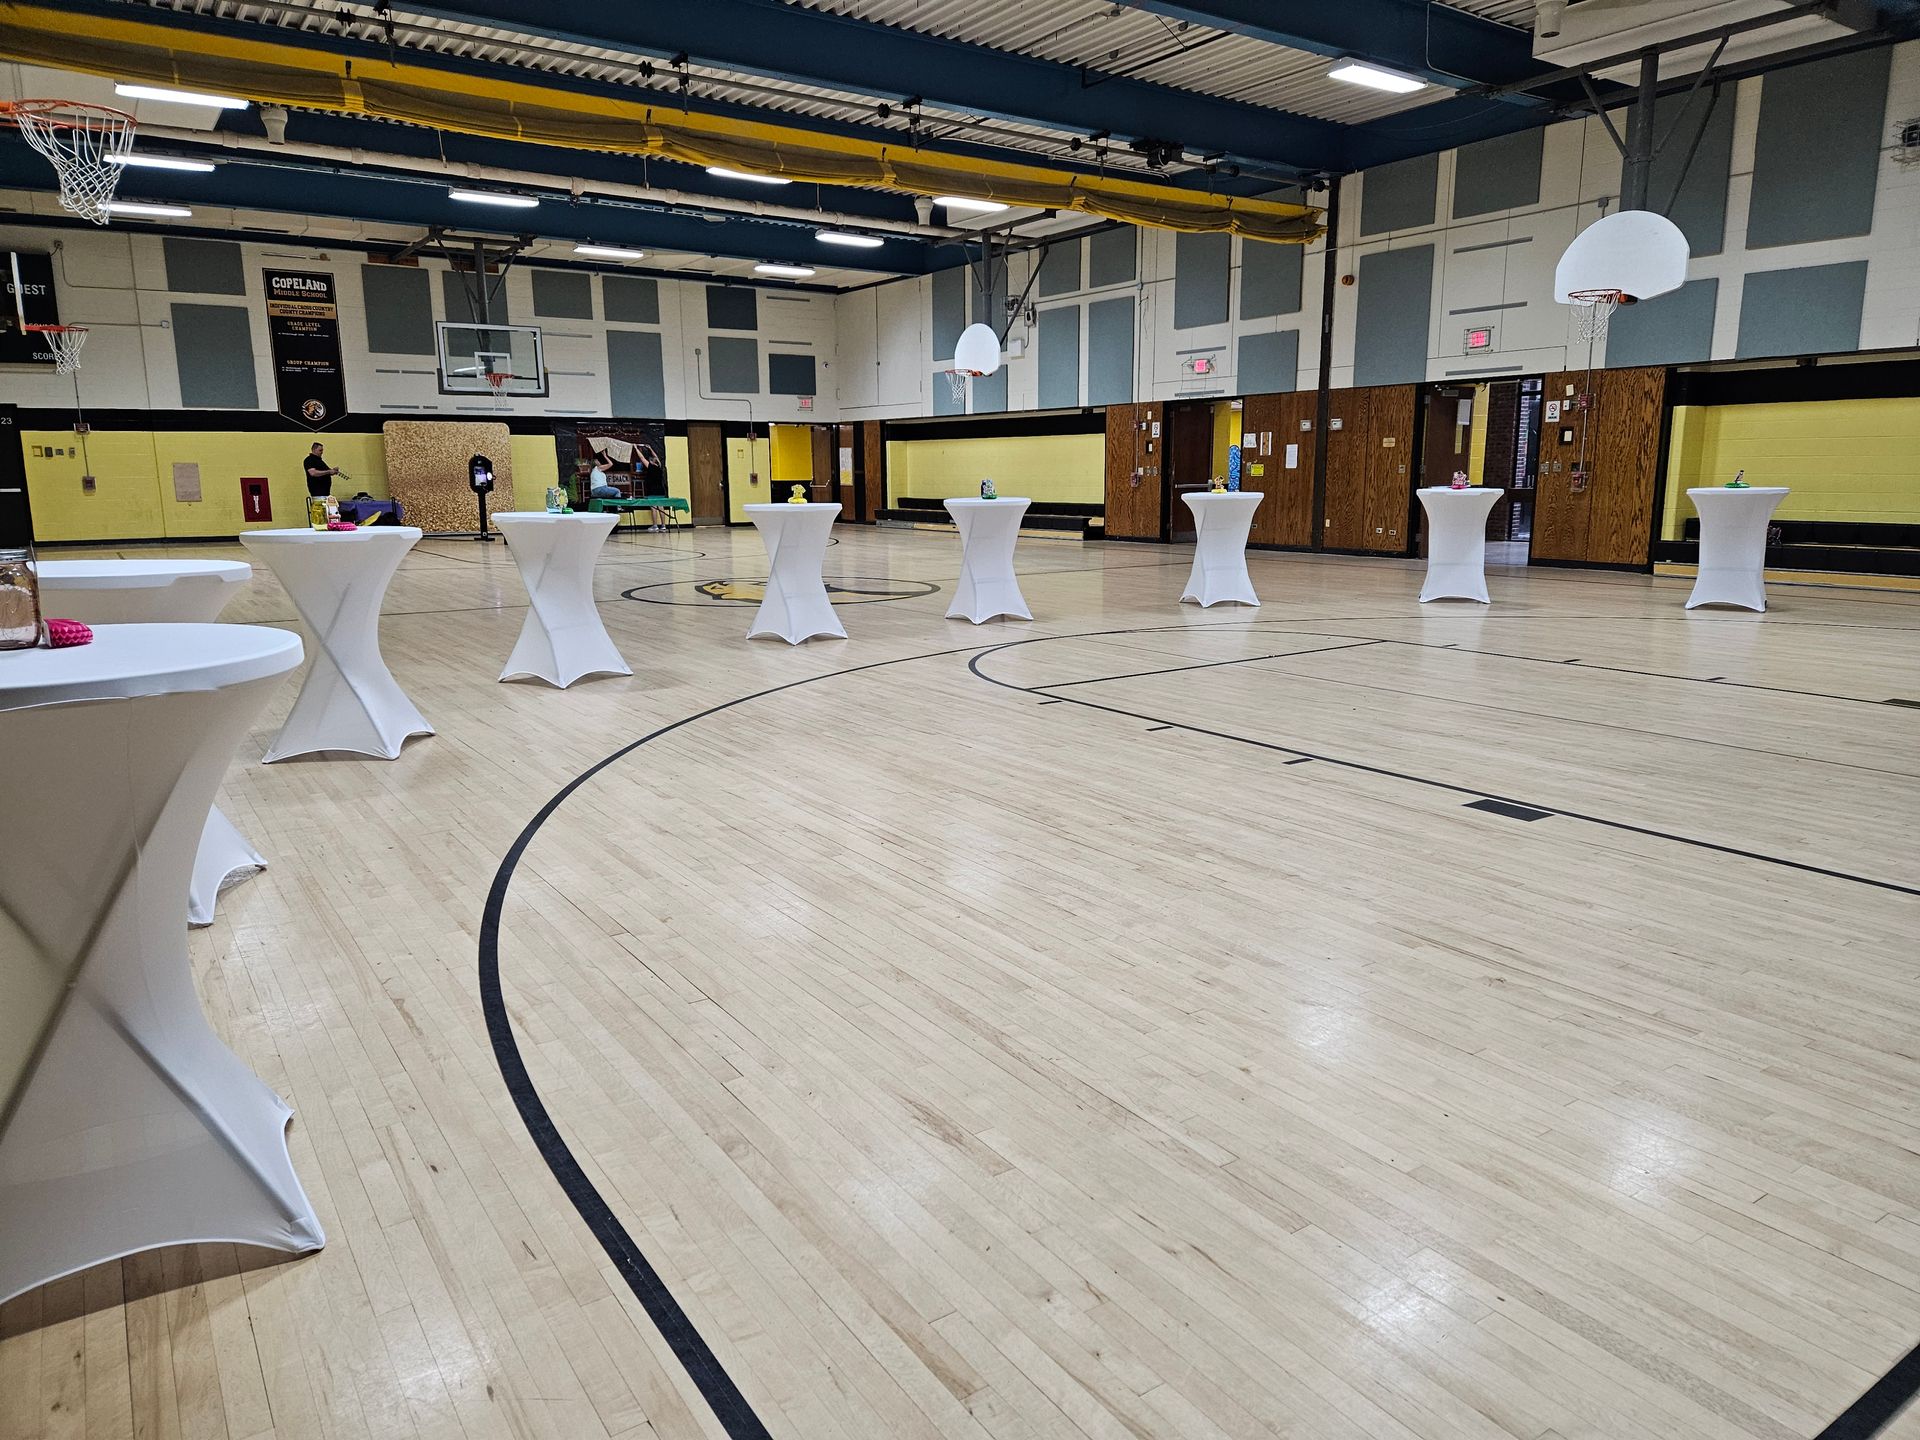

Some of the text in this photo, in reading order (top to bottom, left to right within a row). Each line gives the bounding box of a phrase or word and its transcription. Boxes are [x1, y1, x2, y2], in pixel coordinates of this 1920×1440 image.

[272, 277, 327, 291] COPELAND
[274, 288, 328, 298] MIDDLE SCHOOL
